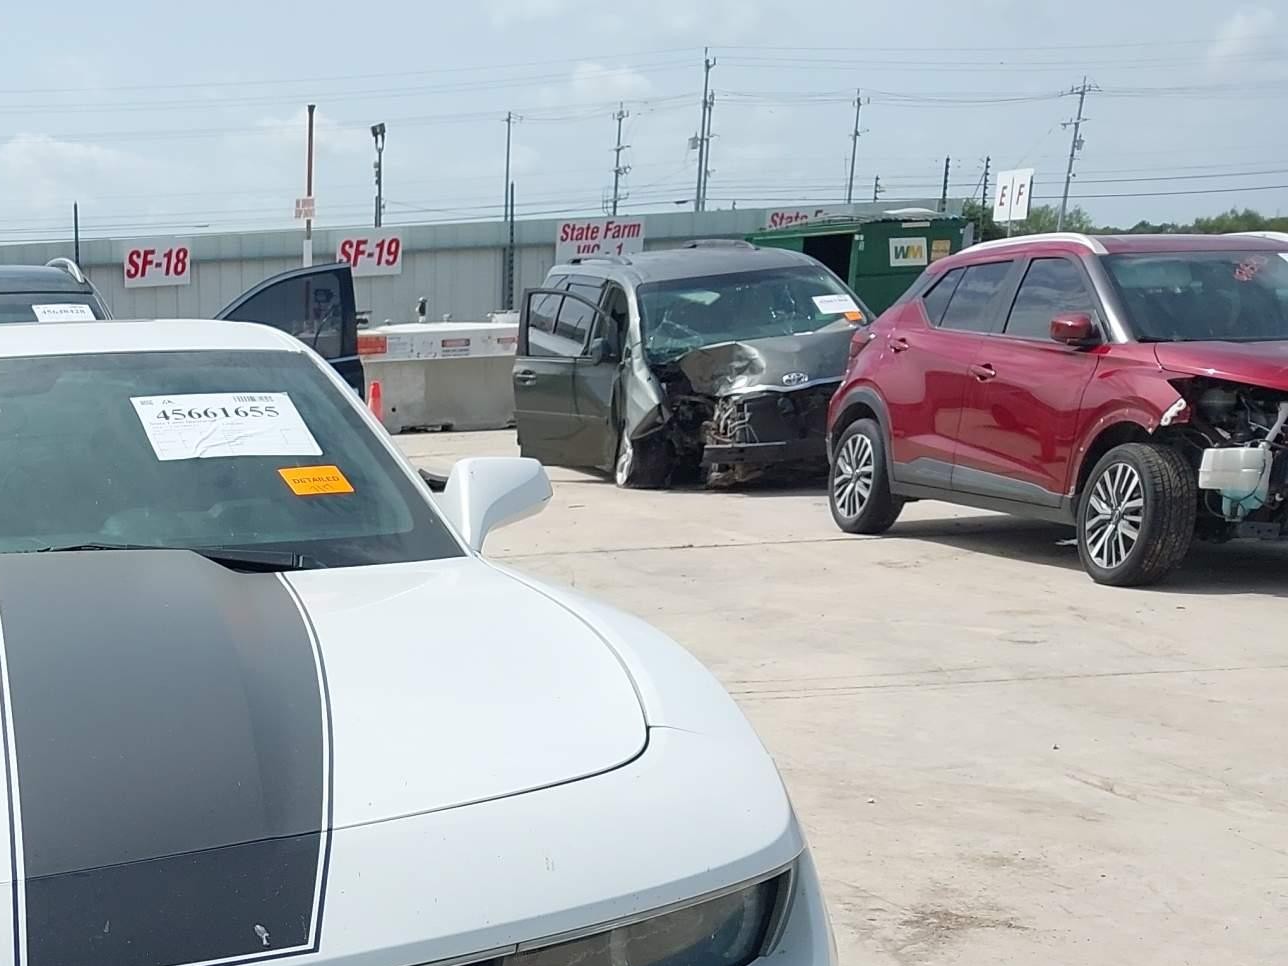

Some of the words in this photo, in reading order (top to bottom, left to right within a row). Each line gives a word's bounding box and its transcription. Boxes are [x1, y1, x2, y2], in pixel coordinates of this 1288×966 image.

[998, 185, 1008, 206] E
[1015, 183, 1025, 205] F
[560, 223, 600, 242] State
[602, 220, 641, 240] Farm
[126, 248, 189, 279] SF-18
[340, 238, 400, 268] SF-19
[894, 245, 923, 260] WM
[156, 405, 280, 421] 45661655
